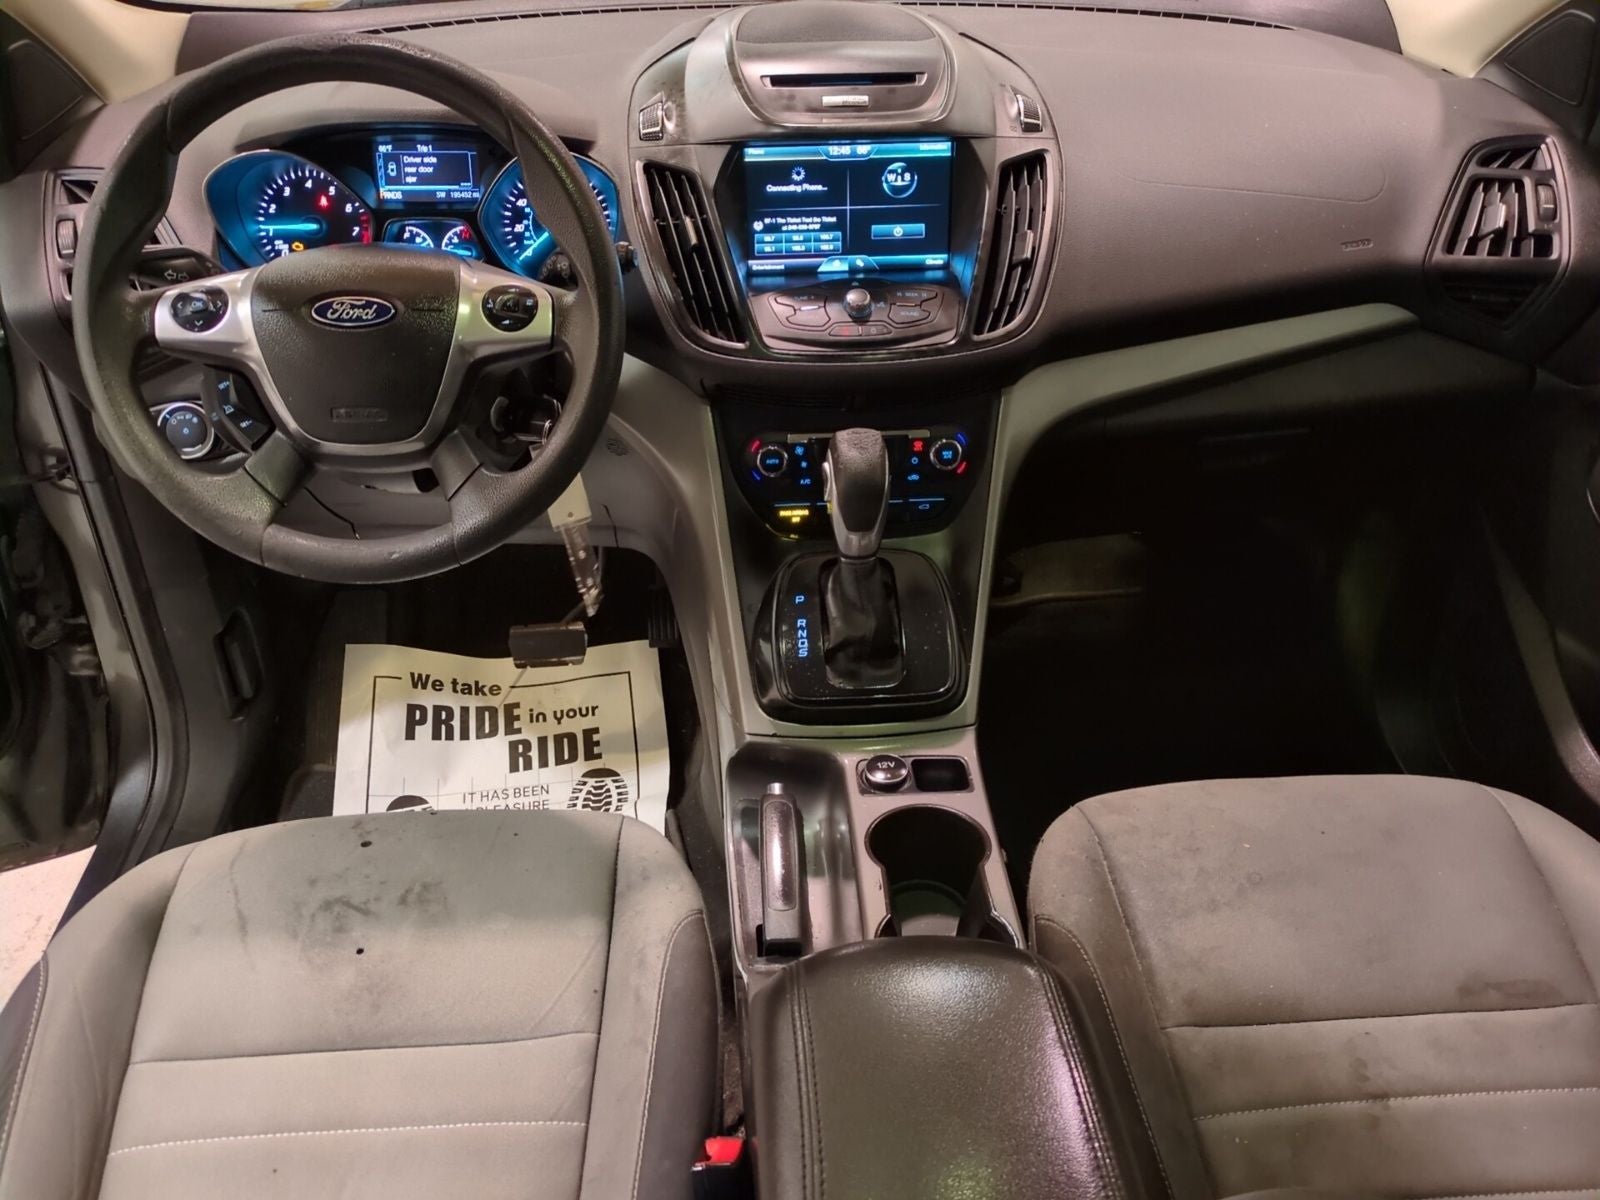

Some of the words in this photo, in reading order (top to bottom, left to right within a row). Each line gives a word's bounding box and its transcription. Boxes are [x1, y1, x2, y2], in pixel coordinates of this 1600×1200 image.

[418, 165, 433, 173] door
[305, 179, 313, 188] 4
[766, 184, 802, 192] Connecting
[283, 187, 291, 197] 3
[329, 186, 336, 196] 5
[516, 198, 528, 207] 40
[269, 204, 276, 214] 2
[345, 203, 353, 213] 6
[352, 226, 360, 236] 7
[326, 299, 378, 320] Ford
[795, 595, 805, 604] P
[797, 619, 806, 628] R
[798, 629, 807, 638] N
[798, 638, 808, 648] D
[798, 648, 808, 657] S
[410, 672, 444, 692] We
[451, 678, 502, 697] take
[405, 702, 522, 741] PRIDE
[529, 708, 546, 724] in
[552, 704, 599, 725] your
[508, 727, 602, 774] RIDE
[877, 761, 895, 769] 12V
[463, 792, 477, 804] IT
[480, 788, 510, 802] HAS
[513, 784, 550, 799] BEEN
